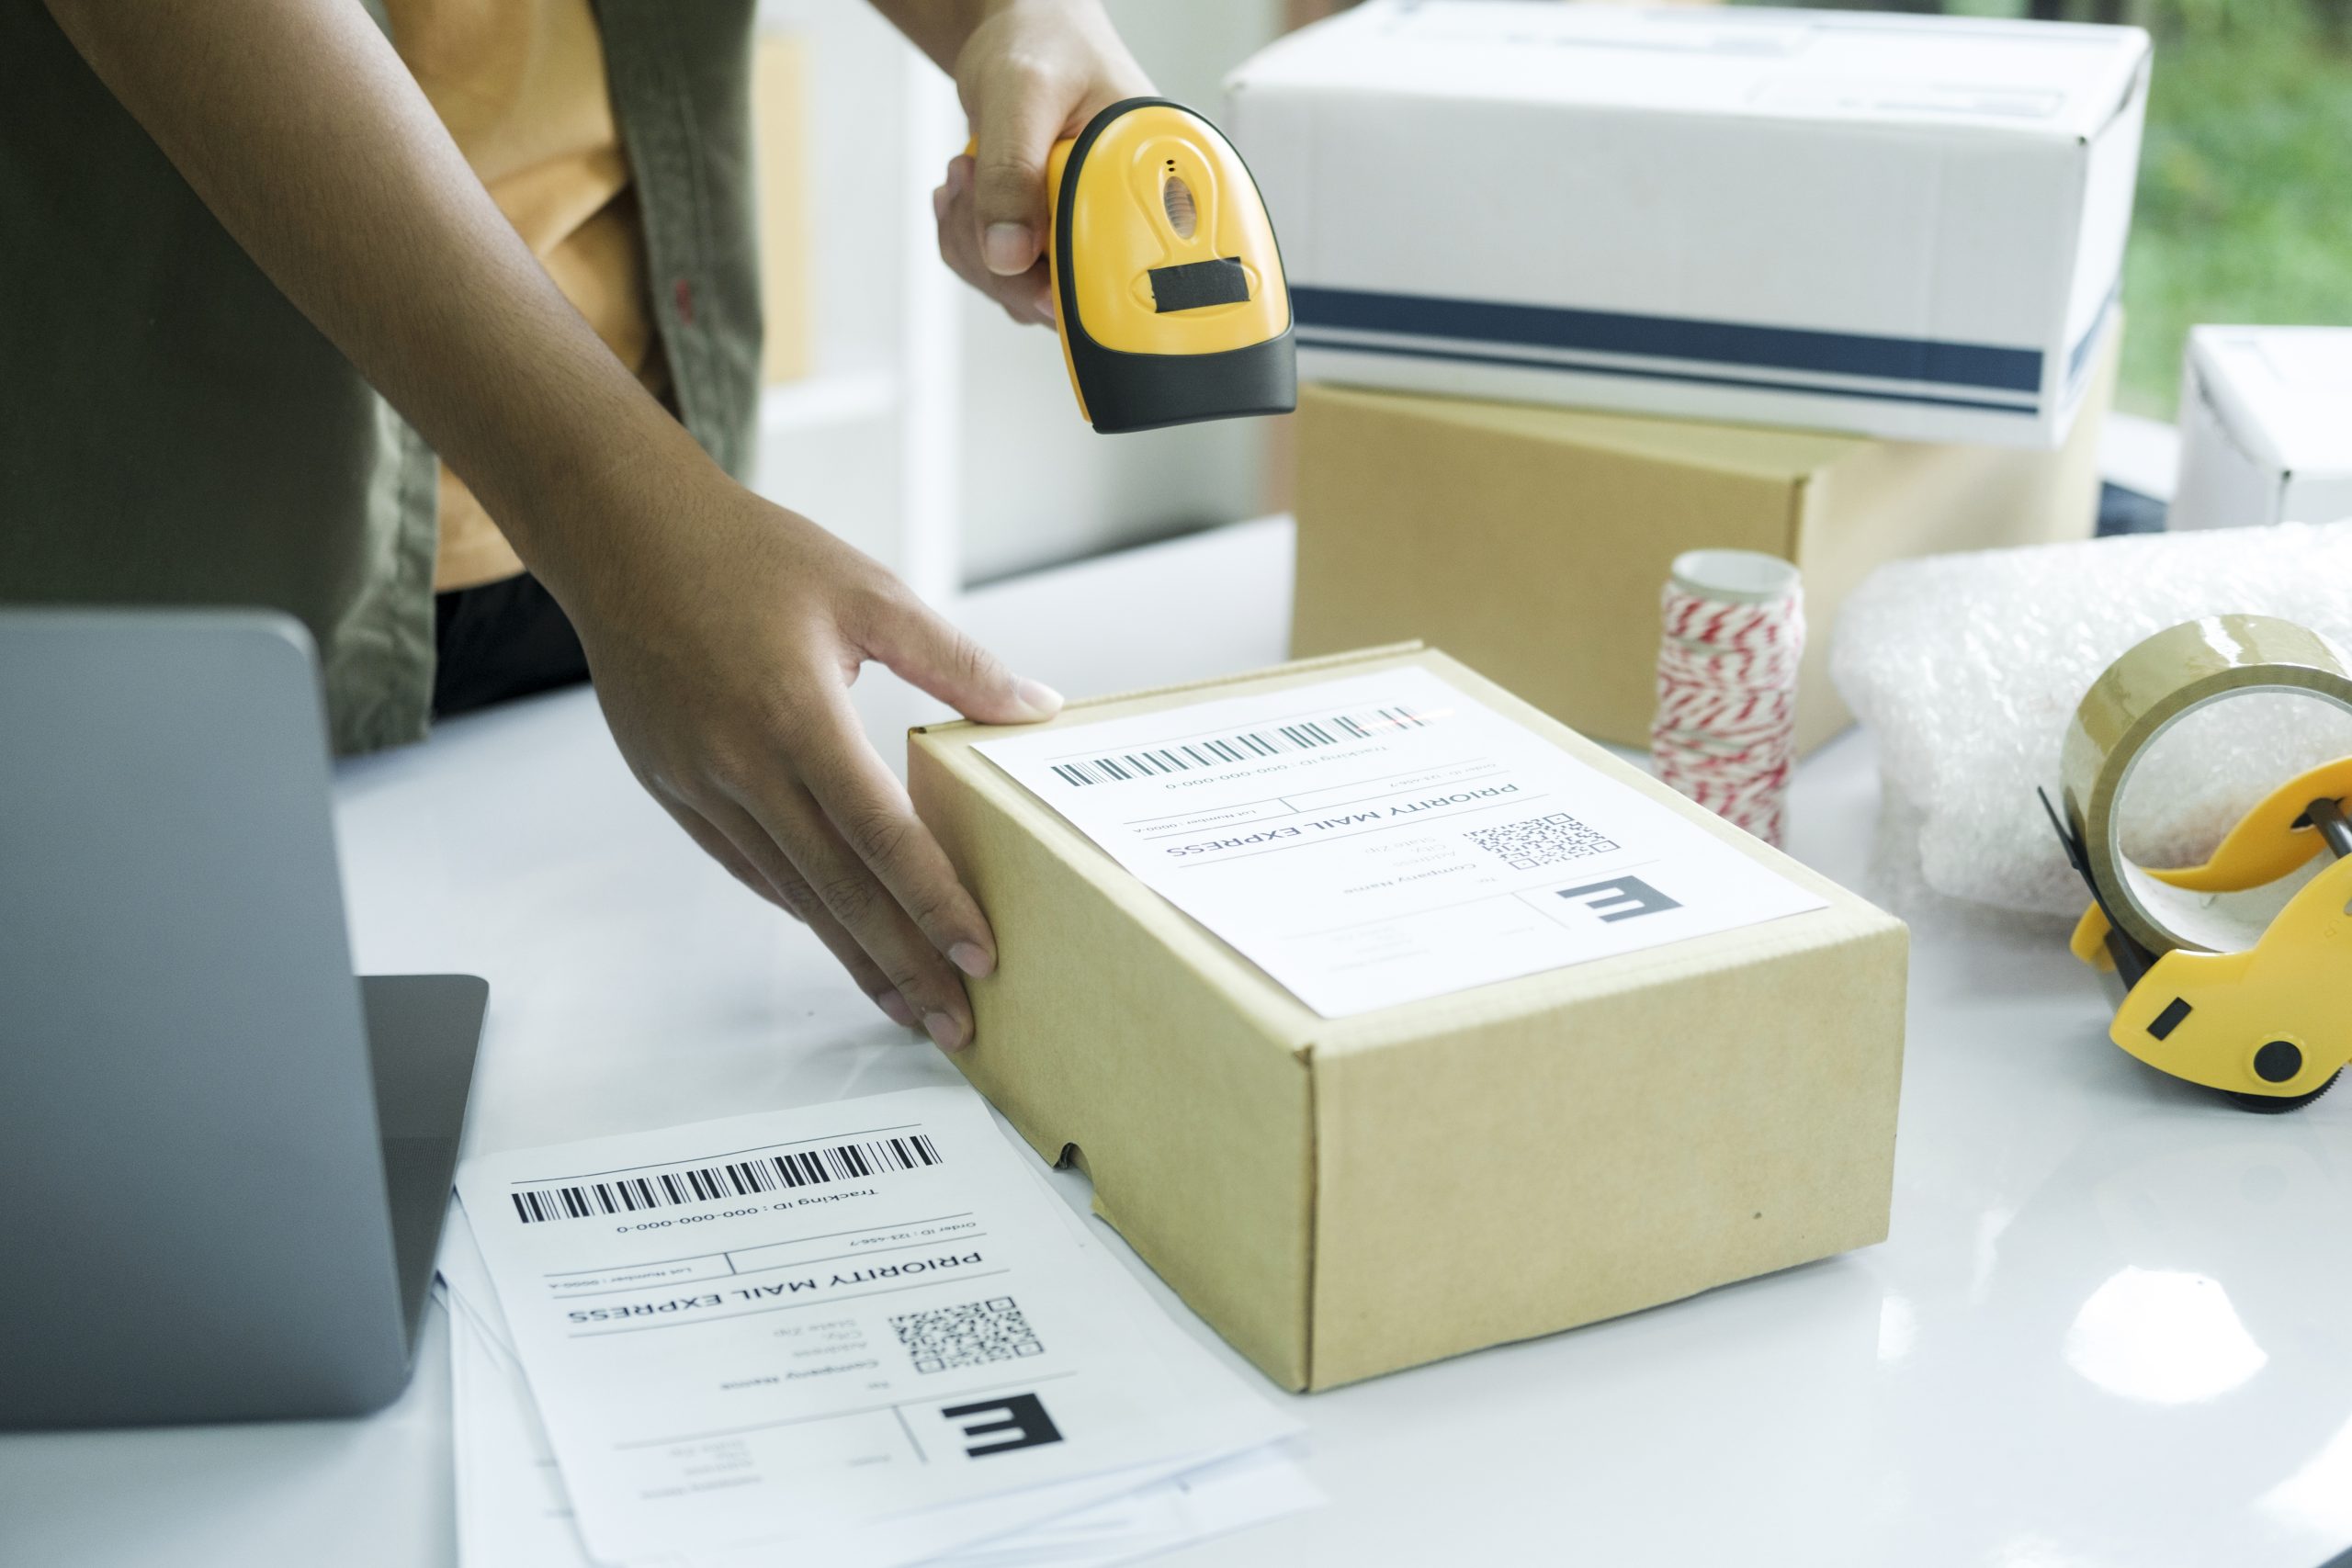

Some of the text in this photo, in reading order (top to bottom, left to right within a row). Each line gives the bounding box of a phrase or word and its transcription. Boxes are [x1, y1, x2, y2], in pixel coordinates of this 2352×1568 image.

[1300, 758, 1317, 766] ID
[1319, 746, 1388, 761] Tracking
[1166, 765, 1287, 790] 000-000-000-0
[1167, 784, 1520, 857] PRIORITY MAIL EXPRESS
[1187, 813, 1235, 825] Number
[1343, 863, 1476, 894] Company Name
[1555, 875, 1684, 923] E
[773, 1202, 793, 1211] ID
[798, 1189, 879, 1205] Tracking
[616, 1207, 759, 1234] 000-000-000-0
[940, 1222, 977, 1232] Order
[568, 1252, 983, 1323] PRIORITY MAIL EXPRESS
[941, 1393, 1065, 1459] E
